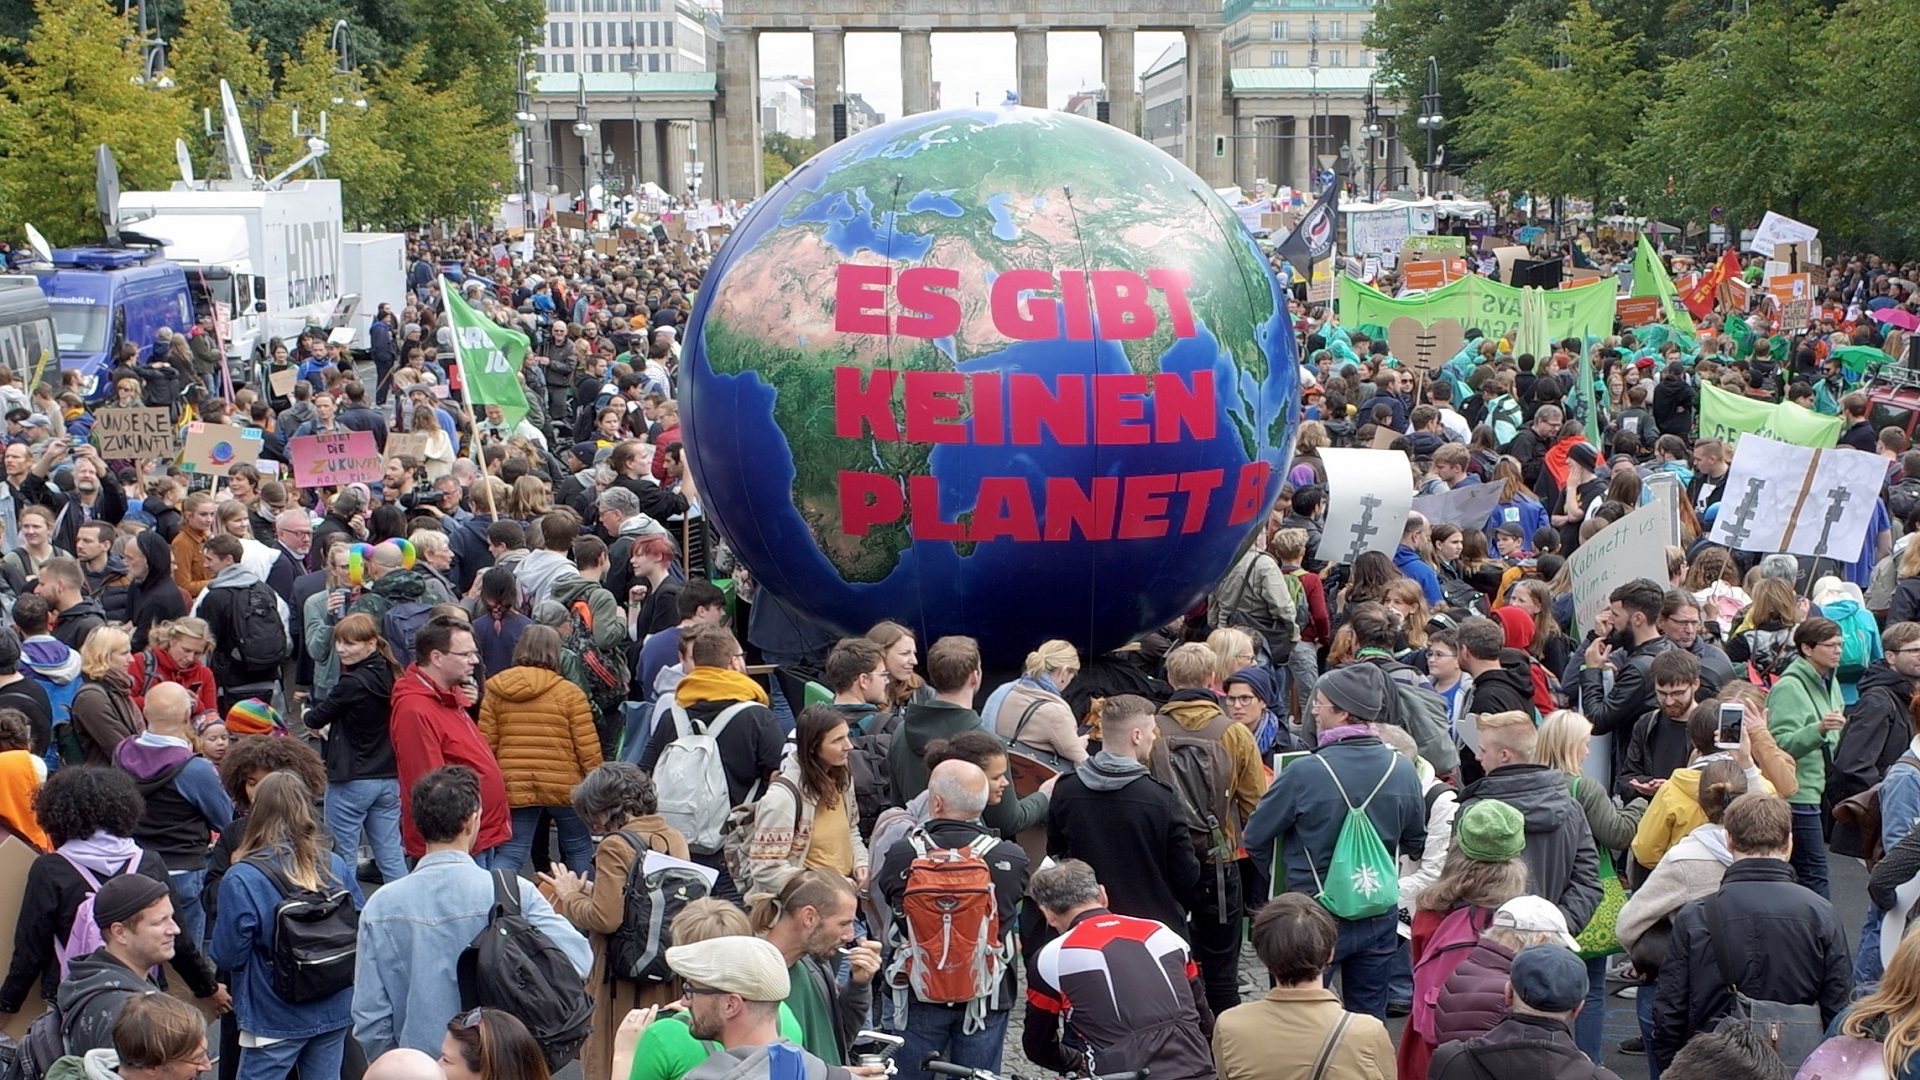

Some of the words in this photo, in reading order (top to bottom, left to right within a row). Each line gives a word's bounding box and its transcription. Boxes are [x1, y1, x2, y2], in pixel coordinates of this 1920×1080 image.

[284, 220, 340, 293] HDTV
[46, 296, 96, 304] tamobil.tv
[834, 264, 962, 339] ES
[990, 268, 1198, 341] GIBT
[101, 413, 168, 433] UNSERE
[834, 366, 1217, 445] KEINEN
[103, 434, 170, 454] ZUKUNFT
[838, 469, 1223, 542] PLANET
[1228, 461, 1270, 527] B
[1571, 524, 1630, 580] Kabinett
